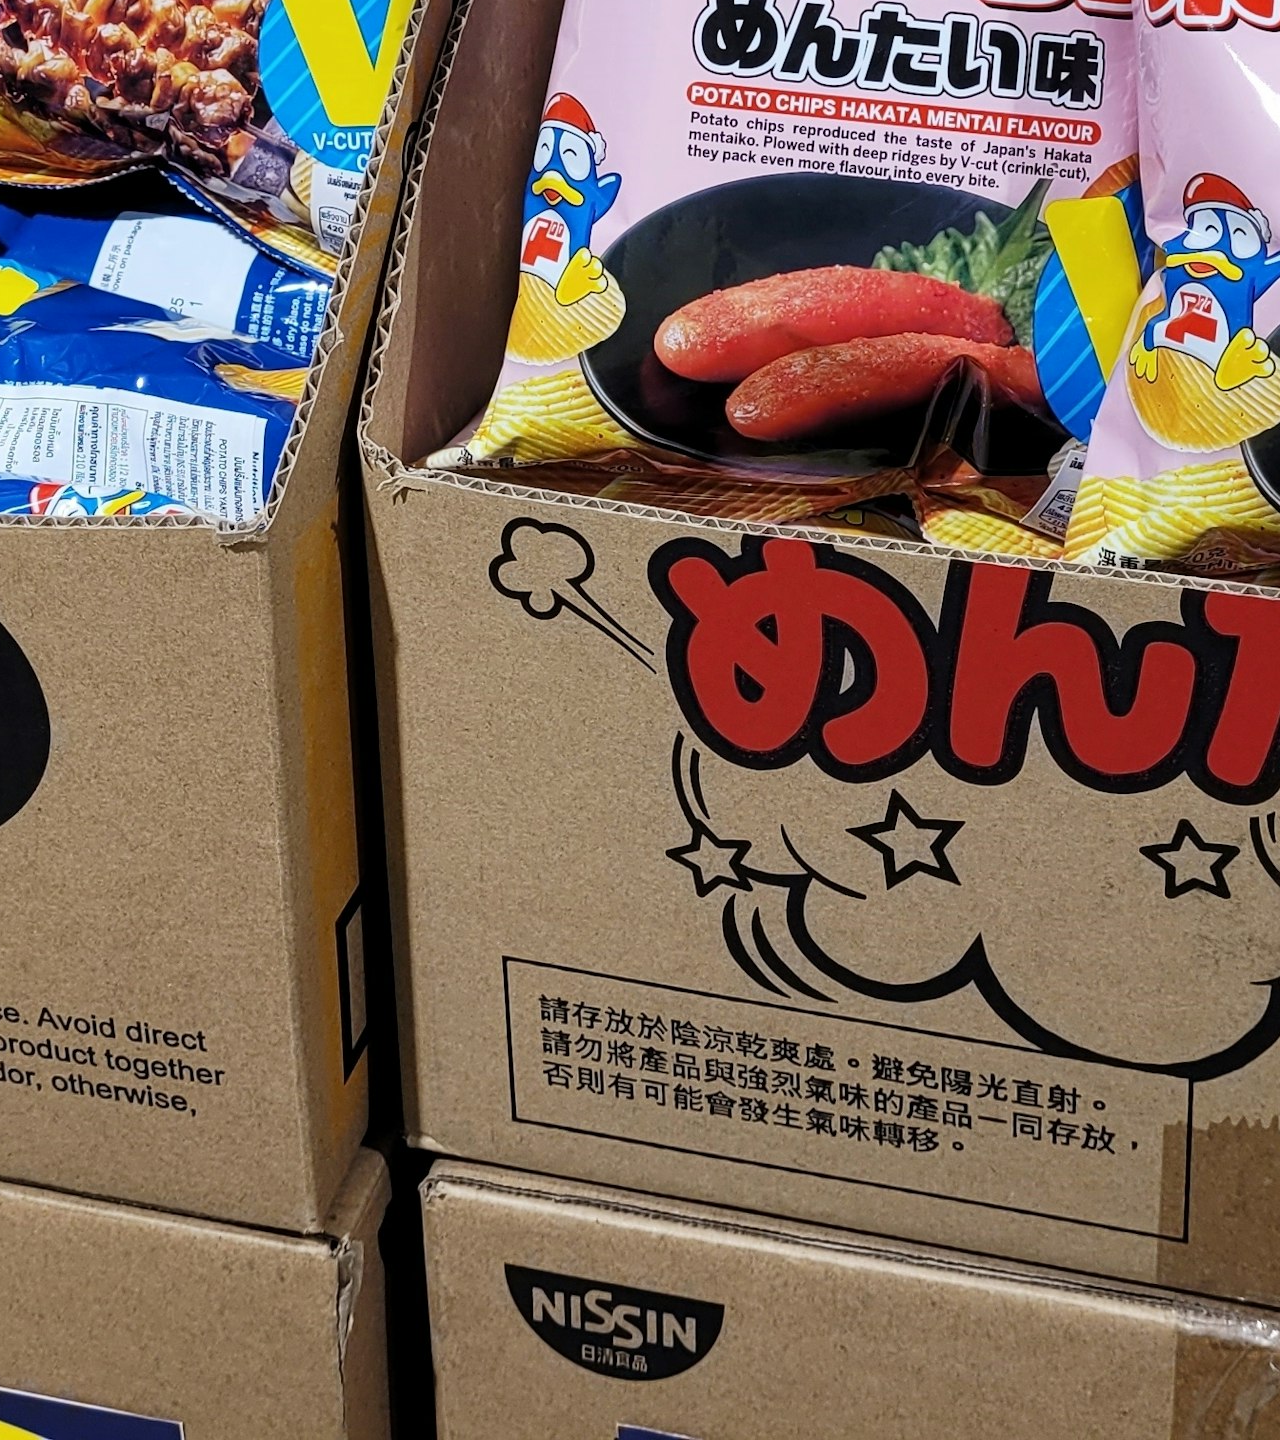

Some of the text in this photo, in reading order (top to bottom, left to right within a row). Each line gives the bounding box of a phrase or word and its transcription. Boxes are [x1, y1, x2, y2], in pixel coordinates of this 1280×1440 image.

[689, 110, 1093, 165] Potato chips reproduced the taste of Japan's Hakata
[690, 85, 1094, 142] POTATO CHIPS HAKATA MENTAI FLAVOUR
[311, 130, 372, 156] V-CUT
[686, 143, 720, 163] they
[721, 149, 757, 164] pack
[759, 154, 795, 168] even
[797, 158, 836, 172] more
[893, 164, 923, 181] into
[925, 171, 966, 188] every
[967, 172, 1000, 189] bite.
[687, 129, 1091, 184] mentaiko. Plowed with deep ridges by V-cut (crinkle-cut),
[538, 992, 1110, 1113] 請存放於陰涼乾爽處。避免陽光直射。
[542, 1060, 970, 1157] 否則有可能會發生氣味轉移。
[531, 1285, 699, 1356] NISSIN
[580, 1343, 651, 1374] 日清食品
